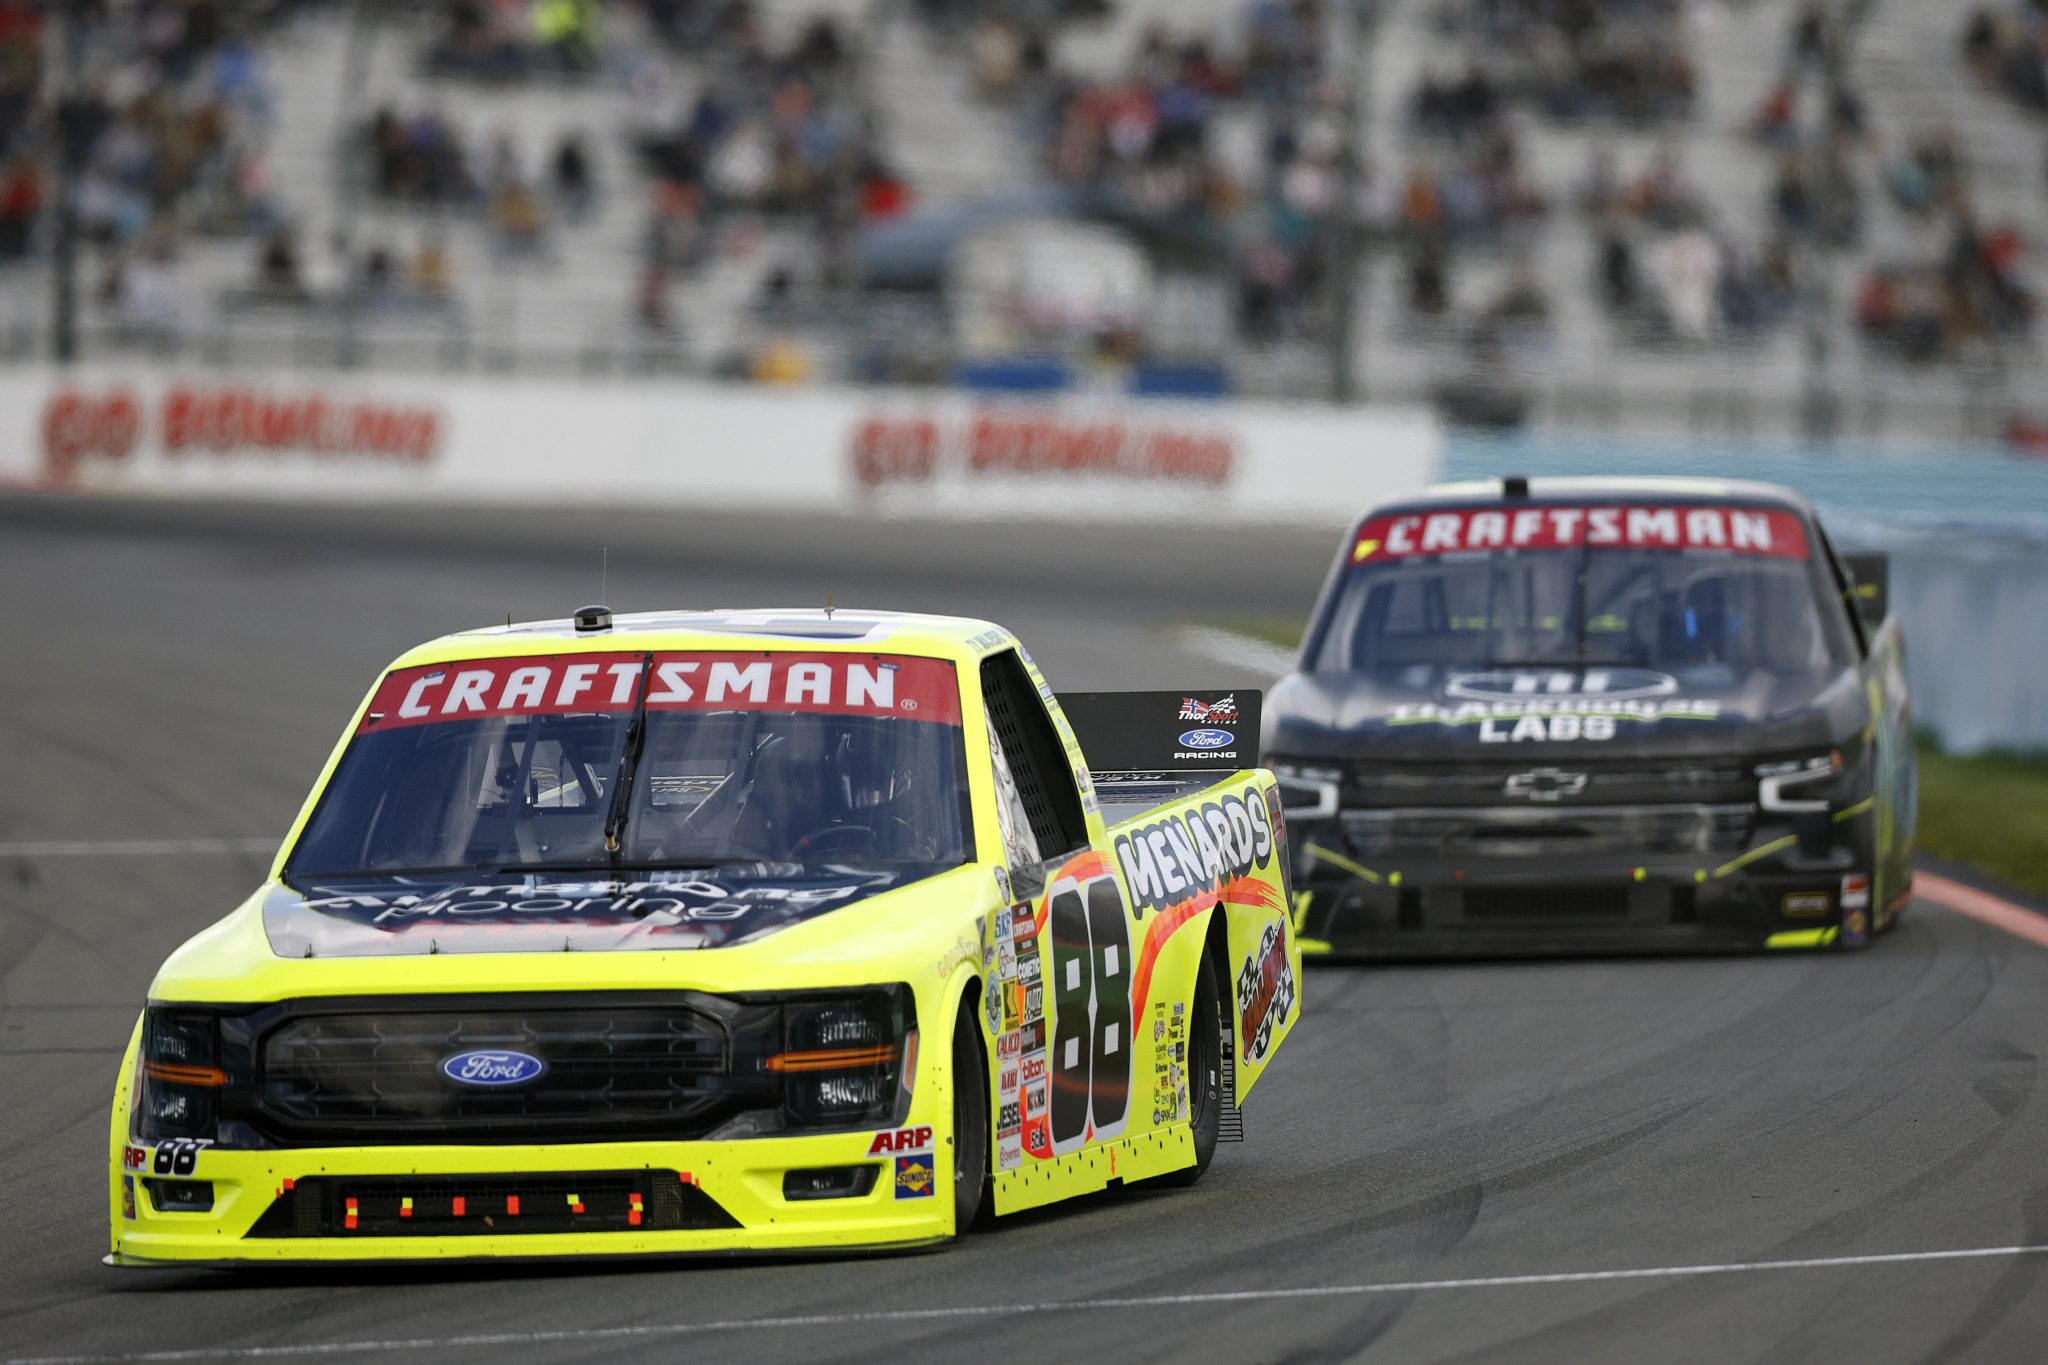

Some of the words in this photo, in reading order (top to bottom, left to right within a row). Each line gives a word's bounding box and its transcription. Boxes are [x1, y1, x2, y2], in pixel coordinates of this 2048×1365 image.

[1385, 509, 1774, 554] CRAFTSMAN
[399, 661, 894, 719] CRAFTSMAN
[1189, 731, 1223, 746] Ford
[1173, 751, 1237, 759] RACING
[1117, 791, 1271, 908] MENARDS
[995, 912, 1011, 938] SKF
[1050, 876, 1132, 1148] 88
[997, 1033, 1020, 1057] CALICO
[460, 1053, 523, 1079] Ford
[996, 1101, 1021, 1131] JESEL
[868, 1126, 932, 1153] ARP
[898, 1169, 934, 1184] SUNOCO
